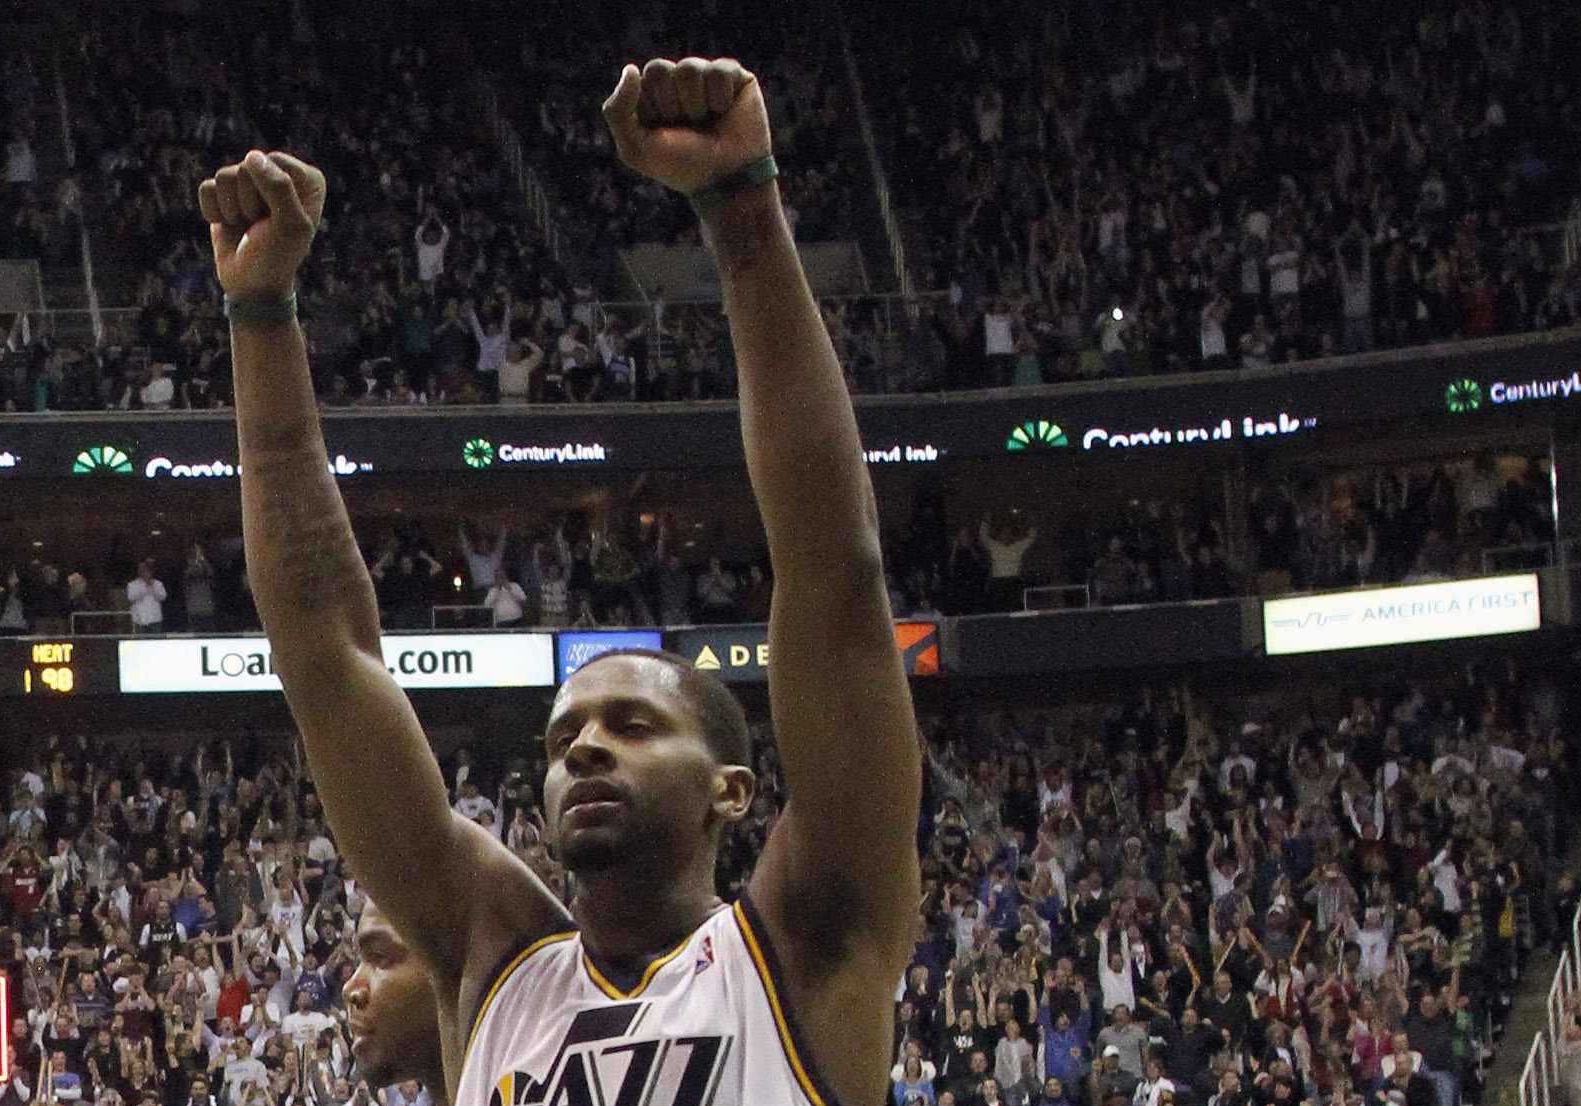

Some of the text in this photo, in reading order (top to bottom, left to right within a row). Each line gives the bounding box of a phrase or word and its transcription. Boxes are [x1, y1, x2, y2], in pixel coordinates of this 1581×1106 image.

[1490, 371, 1581, 403] CenturyL
[499, 443, 605, 464] CenturyLink
[1362, 589, 1534, 623] AMERICA FIRST
[32, 644, 74, 663] HEAT
[41, 667, 74, 691] 98
